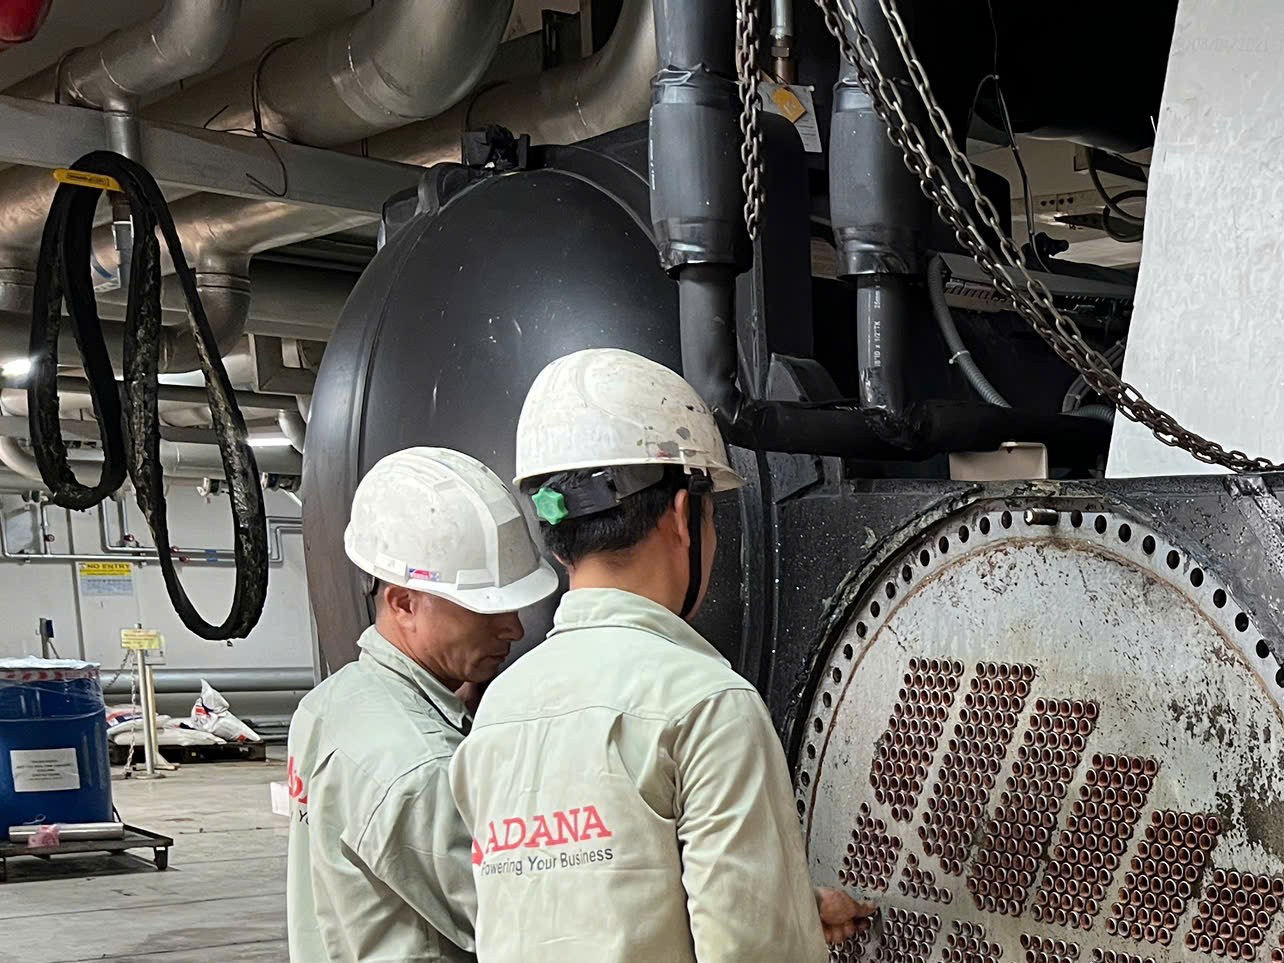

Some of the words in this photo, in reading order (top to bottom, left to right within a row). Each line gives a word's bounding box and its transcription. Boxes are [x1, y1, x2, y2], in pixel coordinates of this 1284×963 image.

[481, 858, 523, 876] Powering
[528, 856, 556, 871] Your
[560, 848, 614, 868] Business
